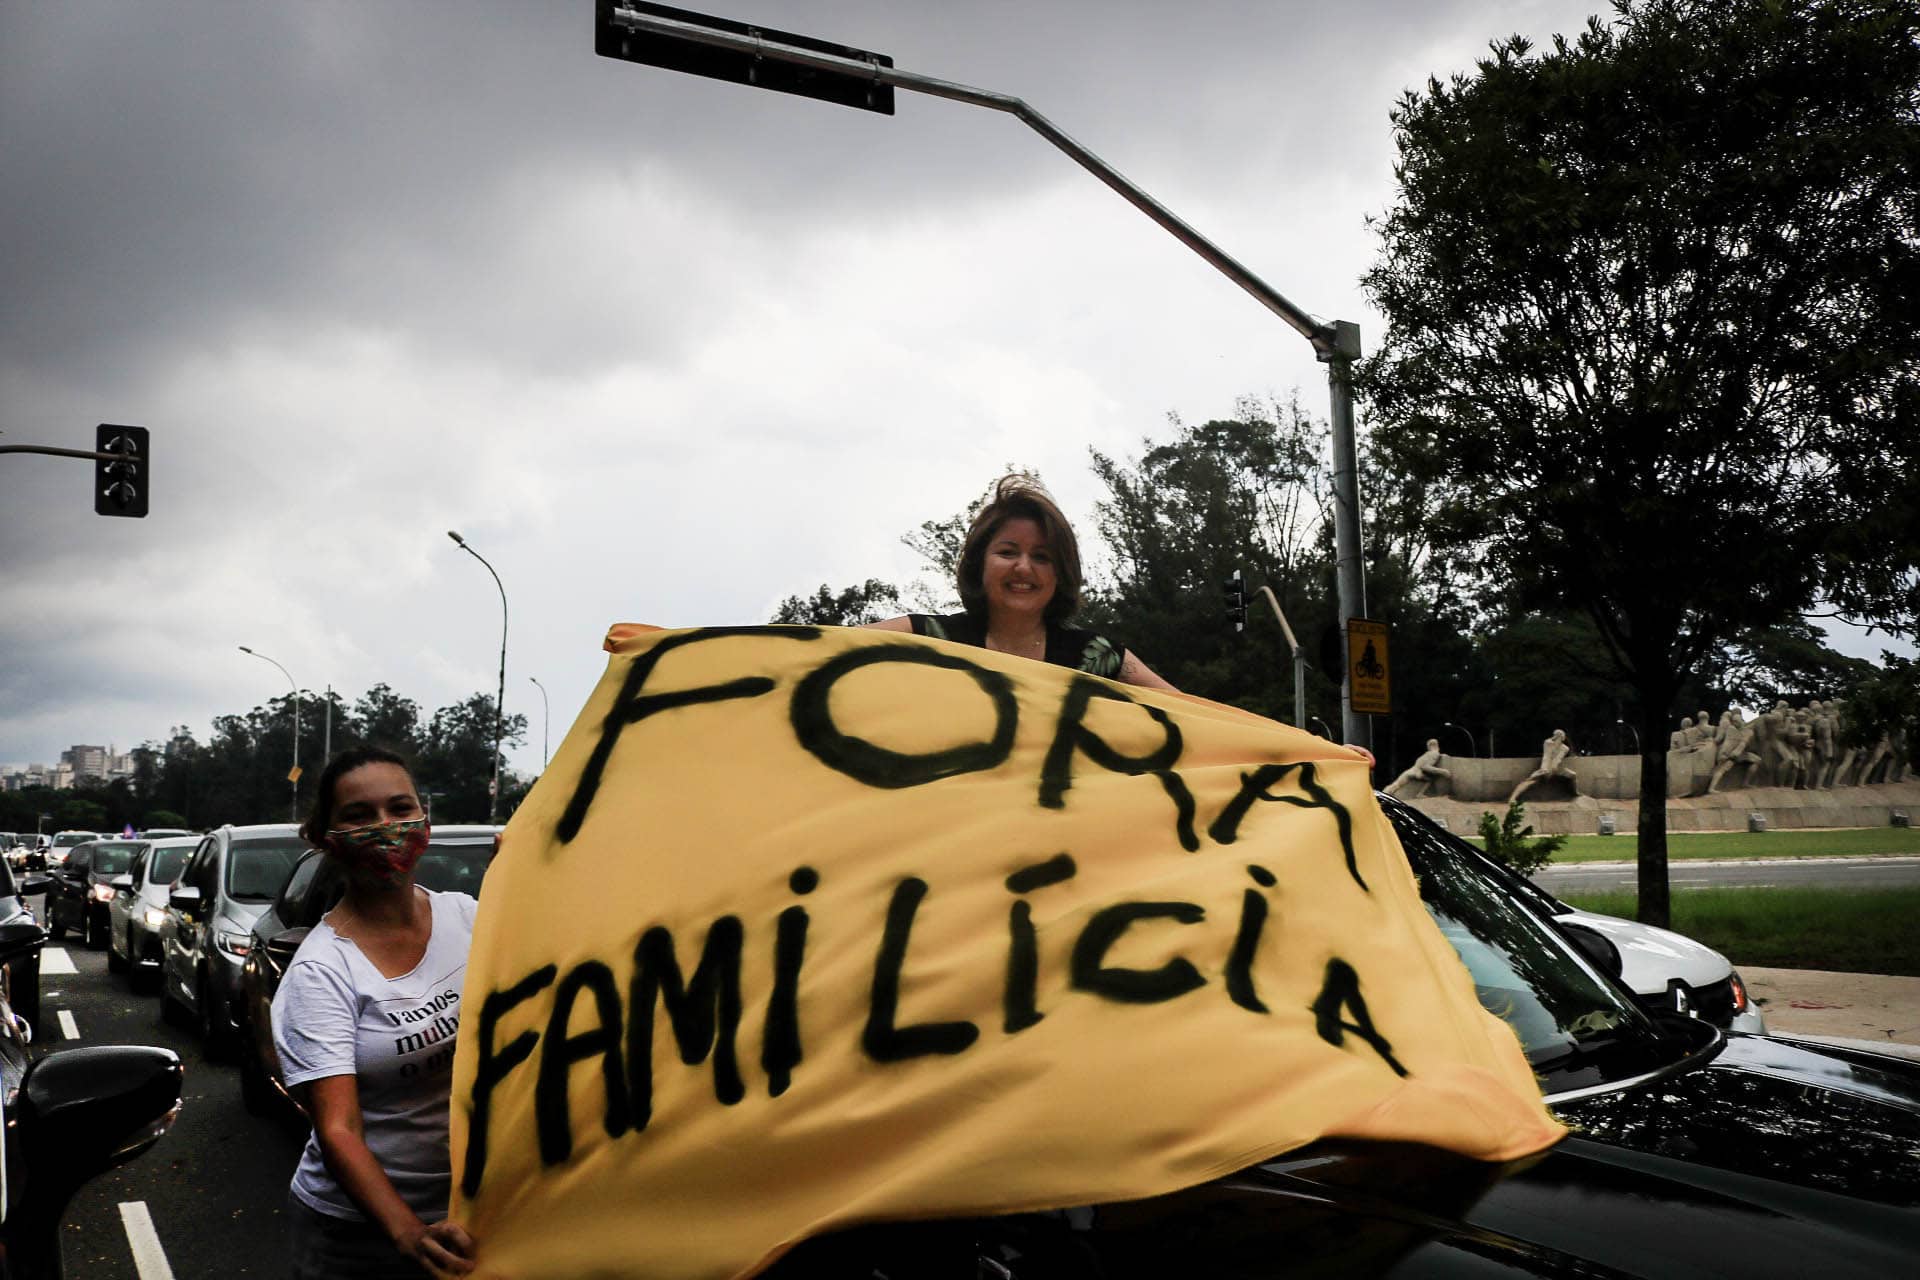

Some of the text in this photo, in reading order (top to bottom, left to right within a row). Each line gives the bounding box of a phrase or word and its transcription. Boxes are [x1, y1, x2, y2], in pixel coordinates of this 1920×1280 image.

[556, 625, 1369, 893] FORA
[387, 989, 459, 1026] Vamos
[395, 1017, 459, 1055] mulh
